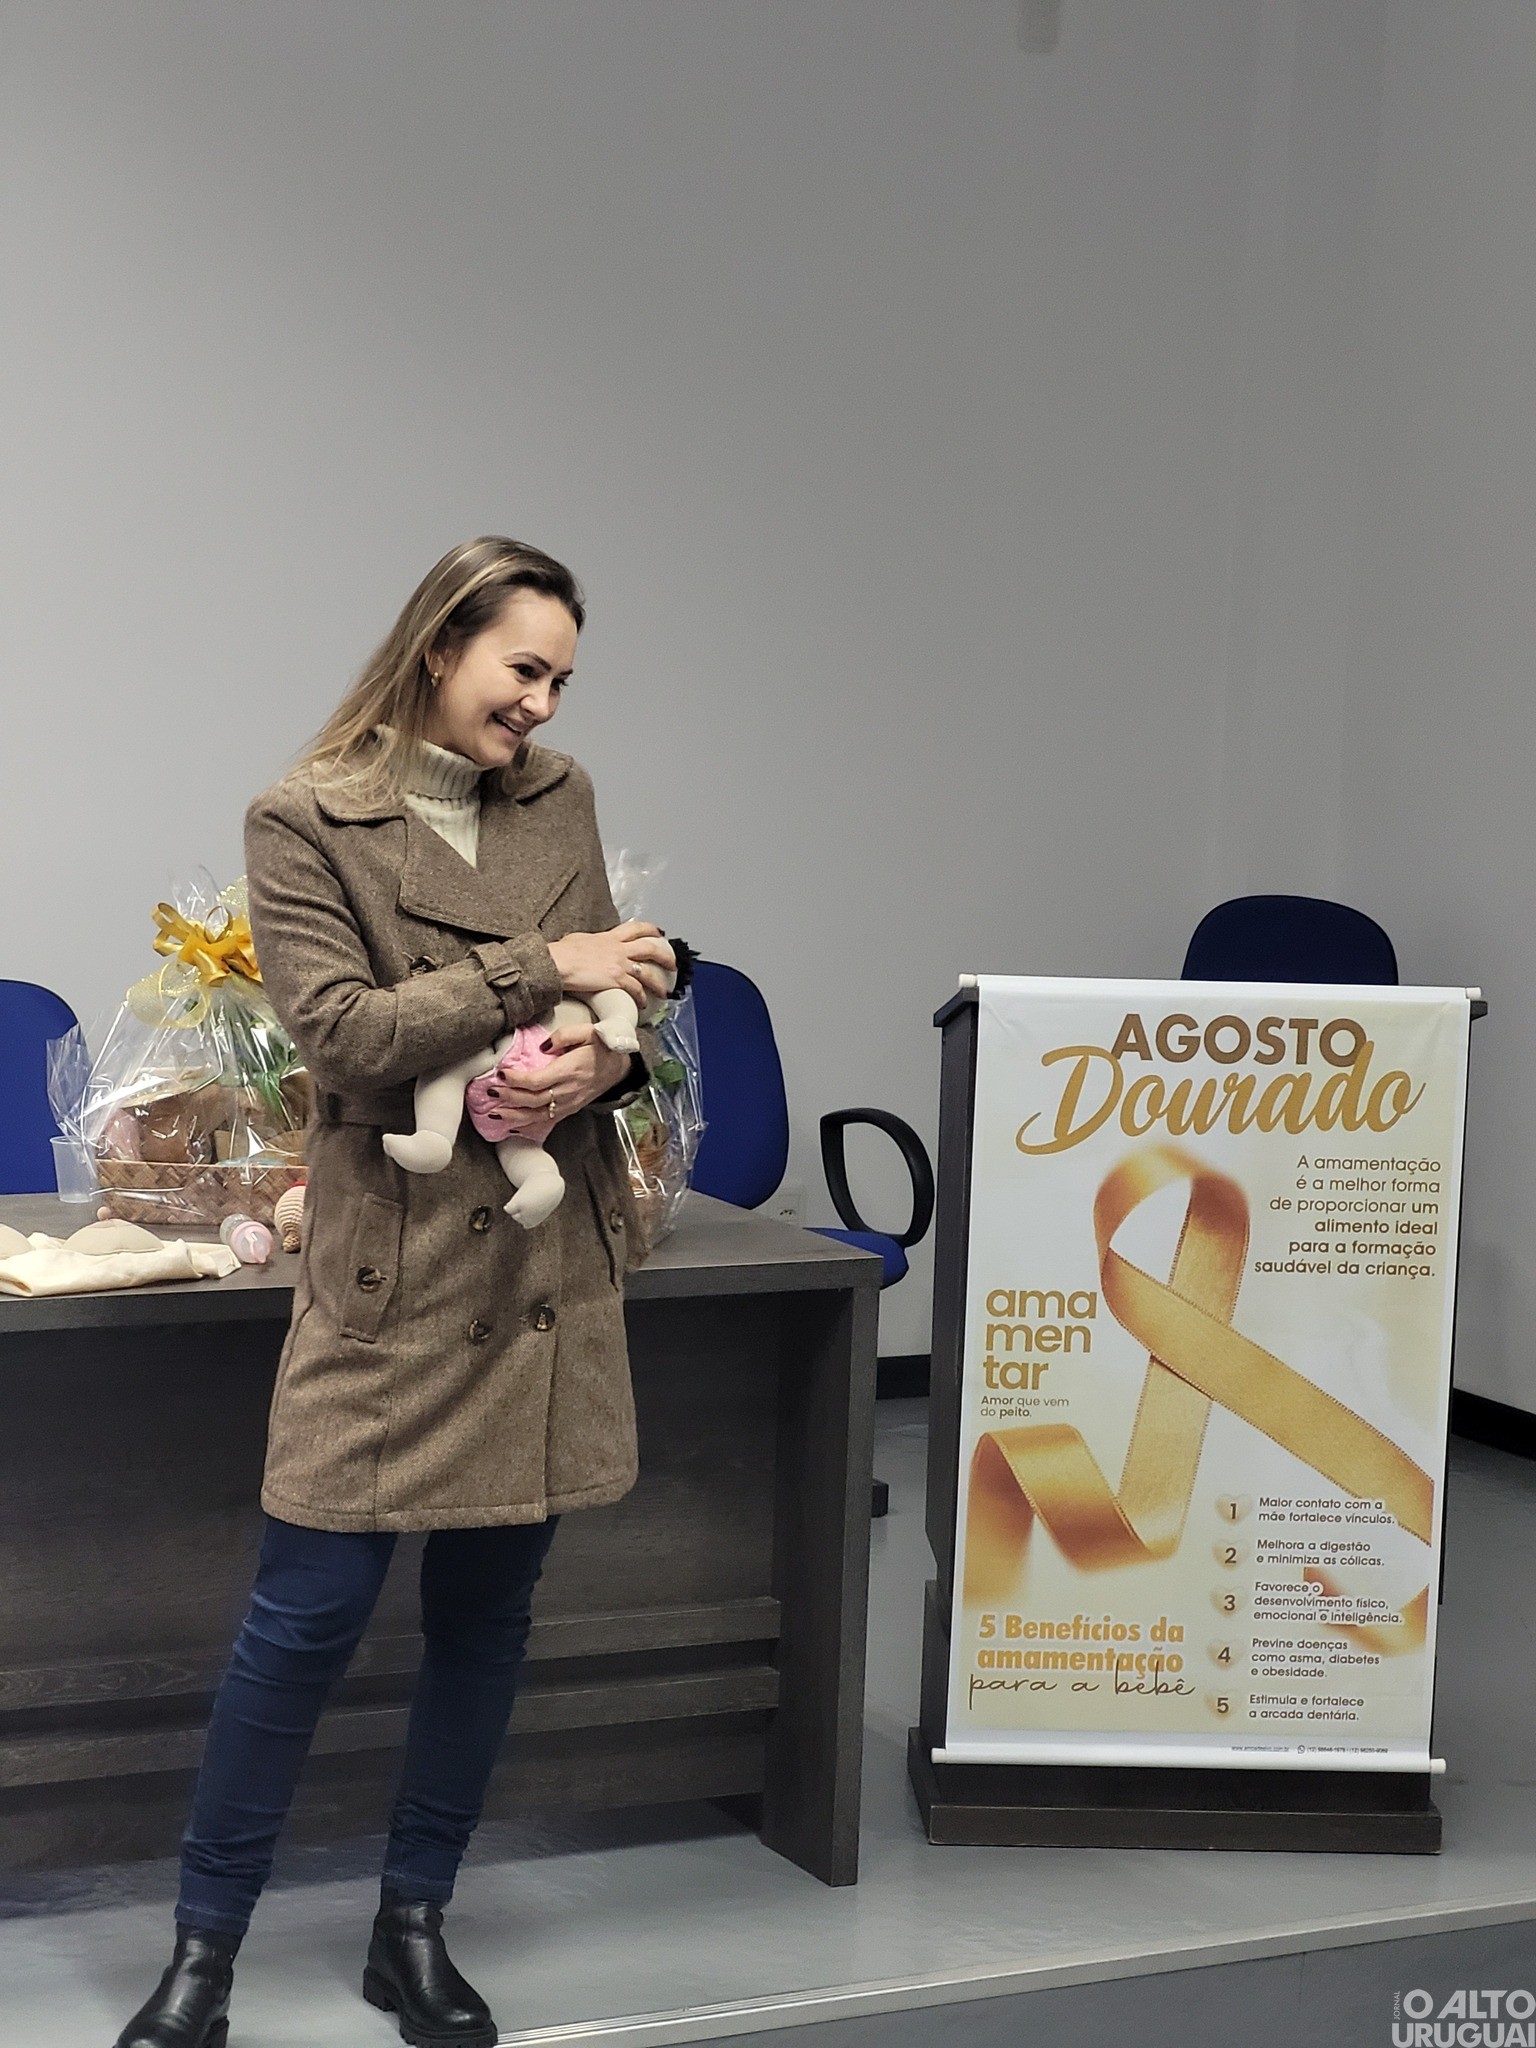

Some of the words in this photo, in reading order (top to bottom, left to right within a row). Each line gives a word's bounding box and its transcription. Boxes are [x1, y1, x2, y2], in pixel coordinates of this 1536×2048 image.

[1110, 1013, 1368, 1067] AGOSTO
[1015, 1040, 1427, 1155] Dourado
[1297, 1155, 1309, 1169] A
[1315, 1157, 1441, 1175] amamentação
[1296, 1175, 1306, 1189] é
[1313, 1179, 1324, 1190] a
[1330, 1178, 1386, 1191] melhor
[1392, 1179, 1440, 1193] forma
[1270, 1197, 1292, 1210] de
[1297, 1199, 1406, 1214] proporcionar
[1412, 1203, 1438, 1214] um
[1315, 1219, 1389, 1234] alimento
[1395, 1221, 1437, 1235] ideal
[1289, 1241, 1329, 1254] para
[1335, 1242, 1346, 1253] a
[1352, 1241, 1436, 1258] formação
[1254, 1259, 1331, 1274] saudável
[1337, 1261, 1359, 1274] da
[1365, 1262, 1435, 1279] criança.
[986, 1289, 1097, 1319] ama
[986, 1324, 1091, 1352] men
[983, 1355, 1049, 1390] tar
[981, 1396, 1014, 1405] Amor
[1017, 1398, 1040, 1407] que
[980, 1408, 996, 1416] do
[1259, 1497, 1292, 1508] Maior
[1295, 1499, 1341, 1509] contato
[1344, 1500, 1371, 1509] com
[1375, 1501, 1383, 1509] a
[1229, 1503, 1237, 1520] 1
[1289, 1512, 1342, 1523] fortalece
[1345, 1513, 1395, 1524] vínculos.
[1257, 1540, 1304, 1550] Melhora
[1309, 1542, 1316, 1550] a
[1320, 1541, 1370, 1554] digestão
[1224, 1548, 1237, 1564] 2
[1256, 1555, 1264, 1563] e
[1268, 1554, 1319, 1564] minimiza
[1324, 1557, 1337, 1565] as
[1340, 1554, 1385, 1566] cólicas.
[1255, 1582, 1309, 1593] Favorece
[1312, 1585, 1320, 1593] o
[1224, 1594, 1236, 1611] 3
[1254, 1596, 1352, 1608] desenvolvimento
[1356, 1598, 1388, 1609] físico,
[1254, 1610, 1316, 1621] emocional
[1320, 1612, 1327, 1621] e
[1331, 1612, 1402, 1624] inteligência.
[979, 1614, 996, 1638] 5
[1005, 1614, 1141, 1641] Benefícios
[1150, 1617, 1184, 1642] da
[1252, 1638, 1293, 1648] Previne
[1297, 1640, 1347, 1652] doenças
[977, 1646, 1184, 1679] amamentação
[1218, 1647, 1231, 1663] 4
[1251, 1654, 1286, 1662] como
[1289, 1656, 1325, 1665] asma,
[1329, 1655, 1379, 1664] diabetes
[1251, 1667, 1258, 1676] e
[1262, 1667, 1327, 1677] obesidade.
[969, 1674, 1058, 1710] para
[1071, 1682, 1100, 1692] a
[1115, 1659, 1196, 1696] bebê
[1217, 1697, 1229, 1713] 5
[1250, 1695, 1297, 1705] Estimula
[1301, 1697, 1308, 1705] e
[1311, 1696, 1364, 1706] fortalece
[1260, 1709, 1303, 1719] arcada
[1307, 1710, 1359, 1721] dentária.
